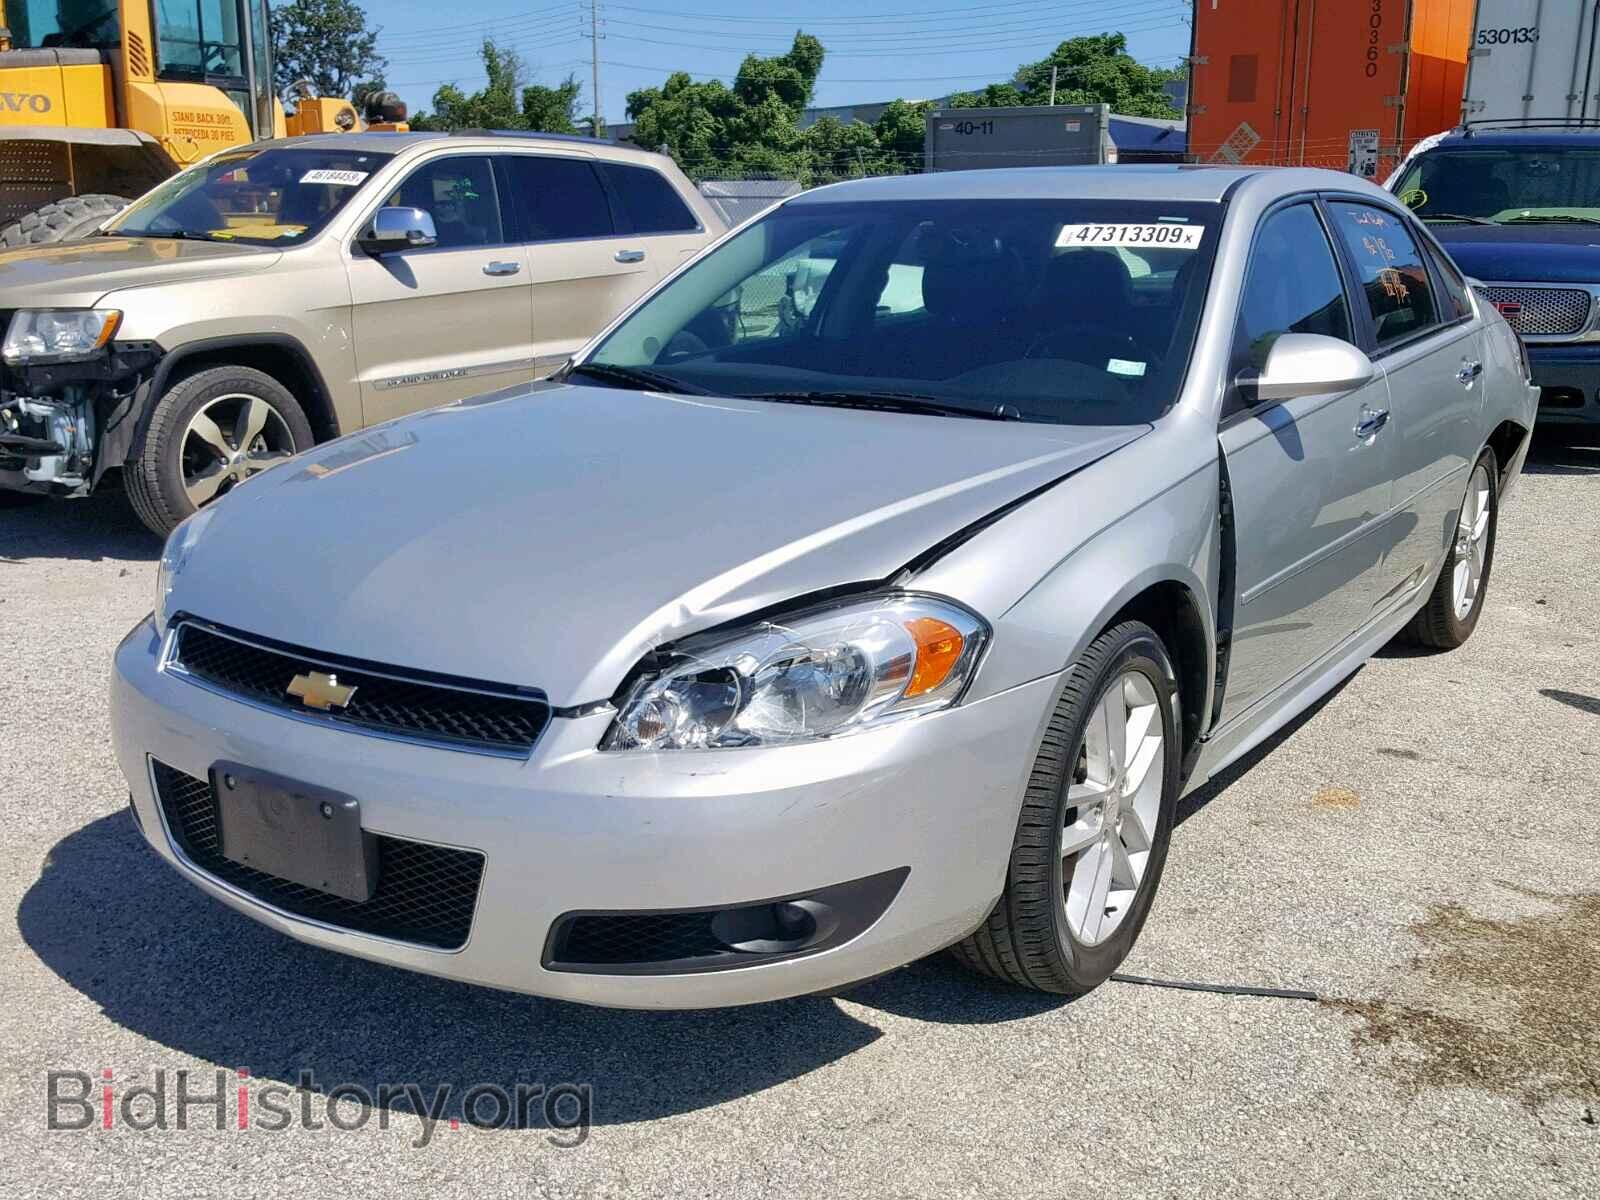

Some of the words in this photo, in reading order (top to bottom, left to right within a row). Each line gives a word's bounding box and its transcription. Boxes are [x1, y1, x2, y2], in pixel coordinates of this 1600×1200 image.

[1477, 27, 1540, 45] 530133
[0, 92, 51, 113] VO
[172, 111, 194, 121] STAND
[196, 113, 214, 123] BACK
[954, 120, 994, 135] 40-11
[220, 131, 235, 141] PIES
